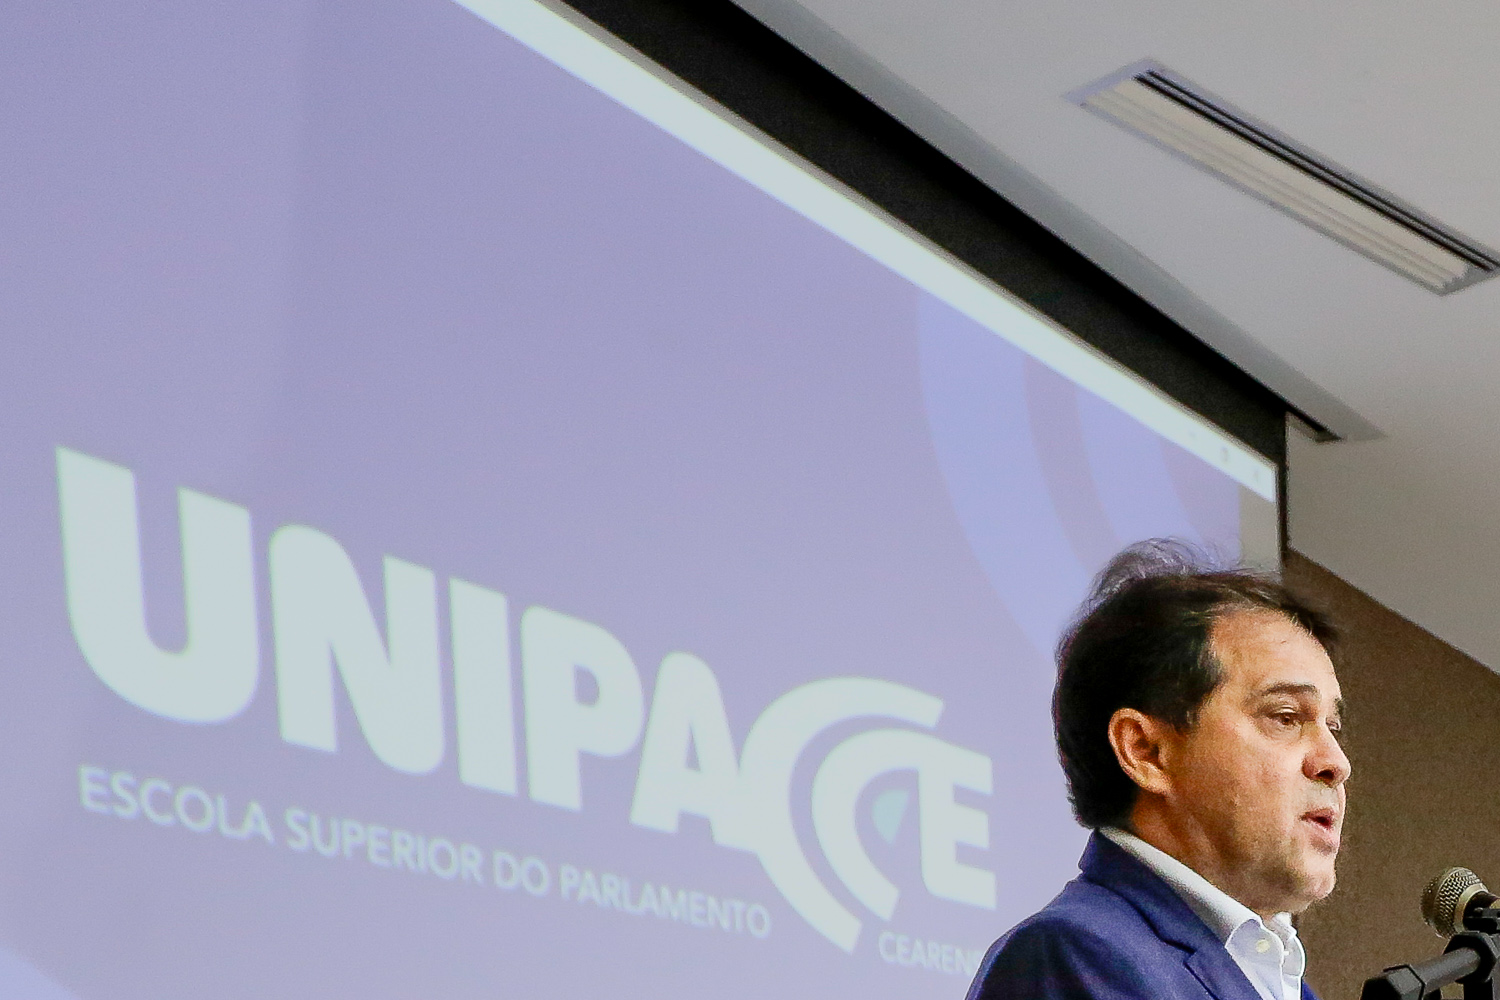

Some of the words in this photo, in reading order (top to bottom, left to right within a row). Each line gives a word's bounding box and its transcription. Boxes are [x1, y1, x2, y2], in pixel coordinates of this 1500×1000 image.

[78, 763, 276, 845] ESCOLA
[284, 805, 484, 885] SUPERIOR
[493, 849, 550, 897] DO
[559, 862, 772, 938] PARLAMENTO
[878, 930, 981, 979] CEAREN
